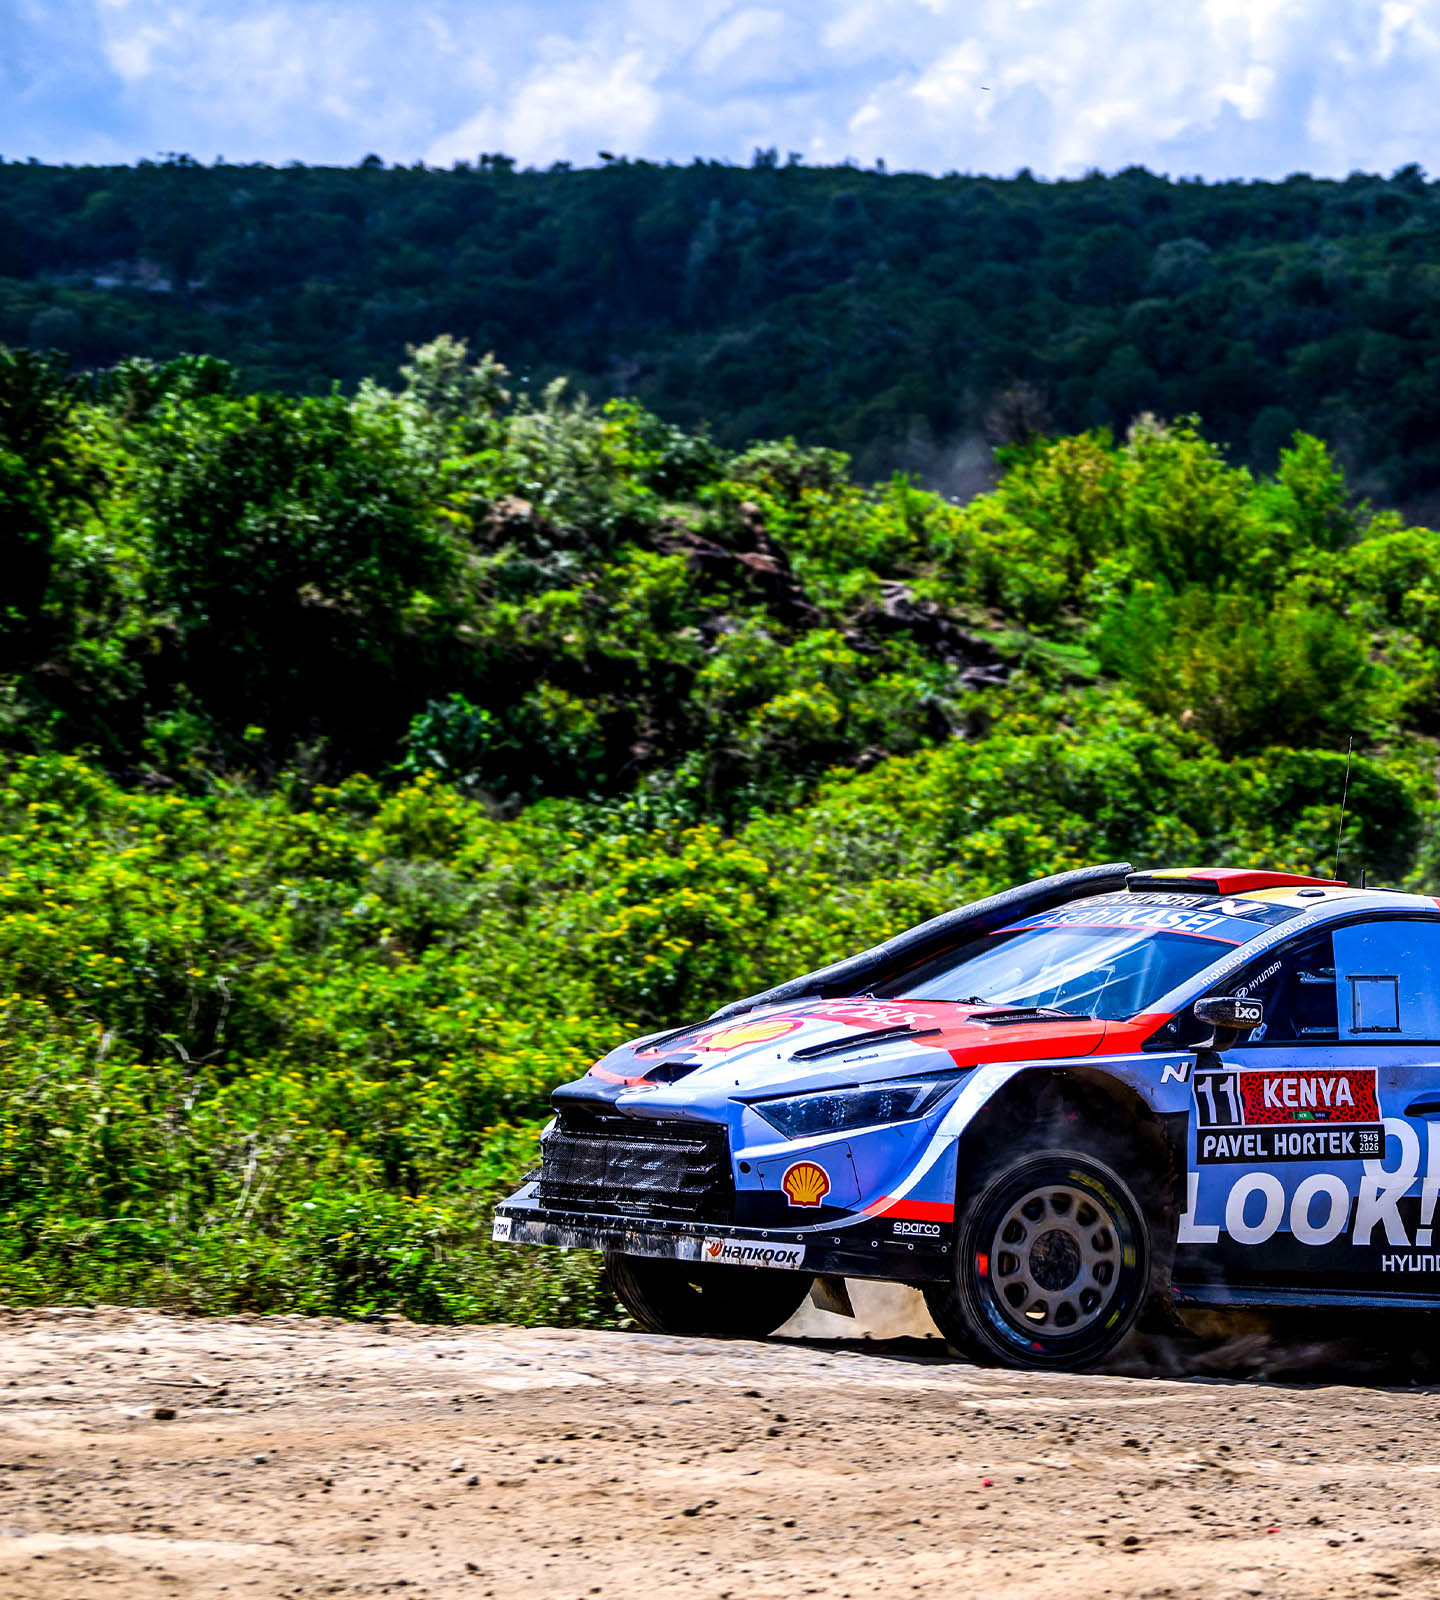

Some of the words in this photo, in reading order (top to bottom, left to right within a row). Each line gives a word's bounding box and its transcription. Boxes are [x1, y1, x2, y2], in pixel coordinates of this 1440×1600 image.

[1201, 915, 1318, 987] motorsport.hyundai.com
[1248, 960, 1283, 991] HYUNDAI
[1197, 1076, 1241, 1124] 11
[1263, 1077, 1355, 1108] KENYA
[1203, 1132, 1269, 1158] PAVEL
[1273, 1131, 1357, 1156] HORTEK
[1359, 1133, 1379, 1142] 1949
[1359, 1142, 1379, 1151] 2026
[1177, 1171, 1440, 1247] LOOK!
[893, 1221, 941, 1238] sparco
